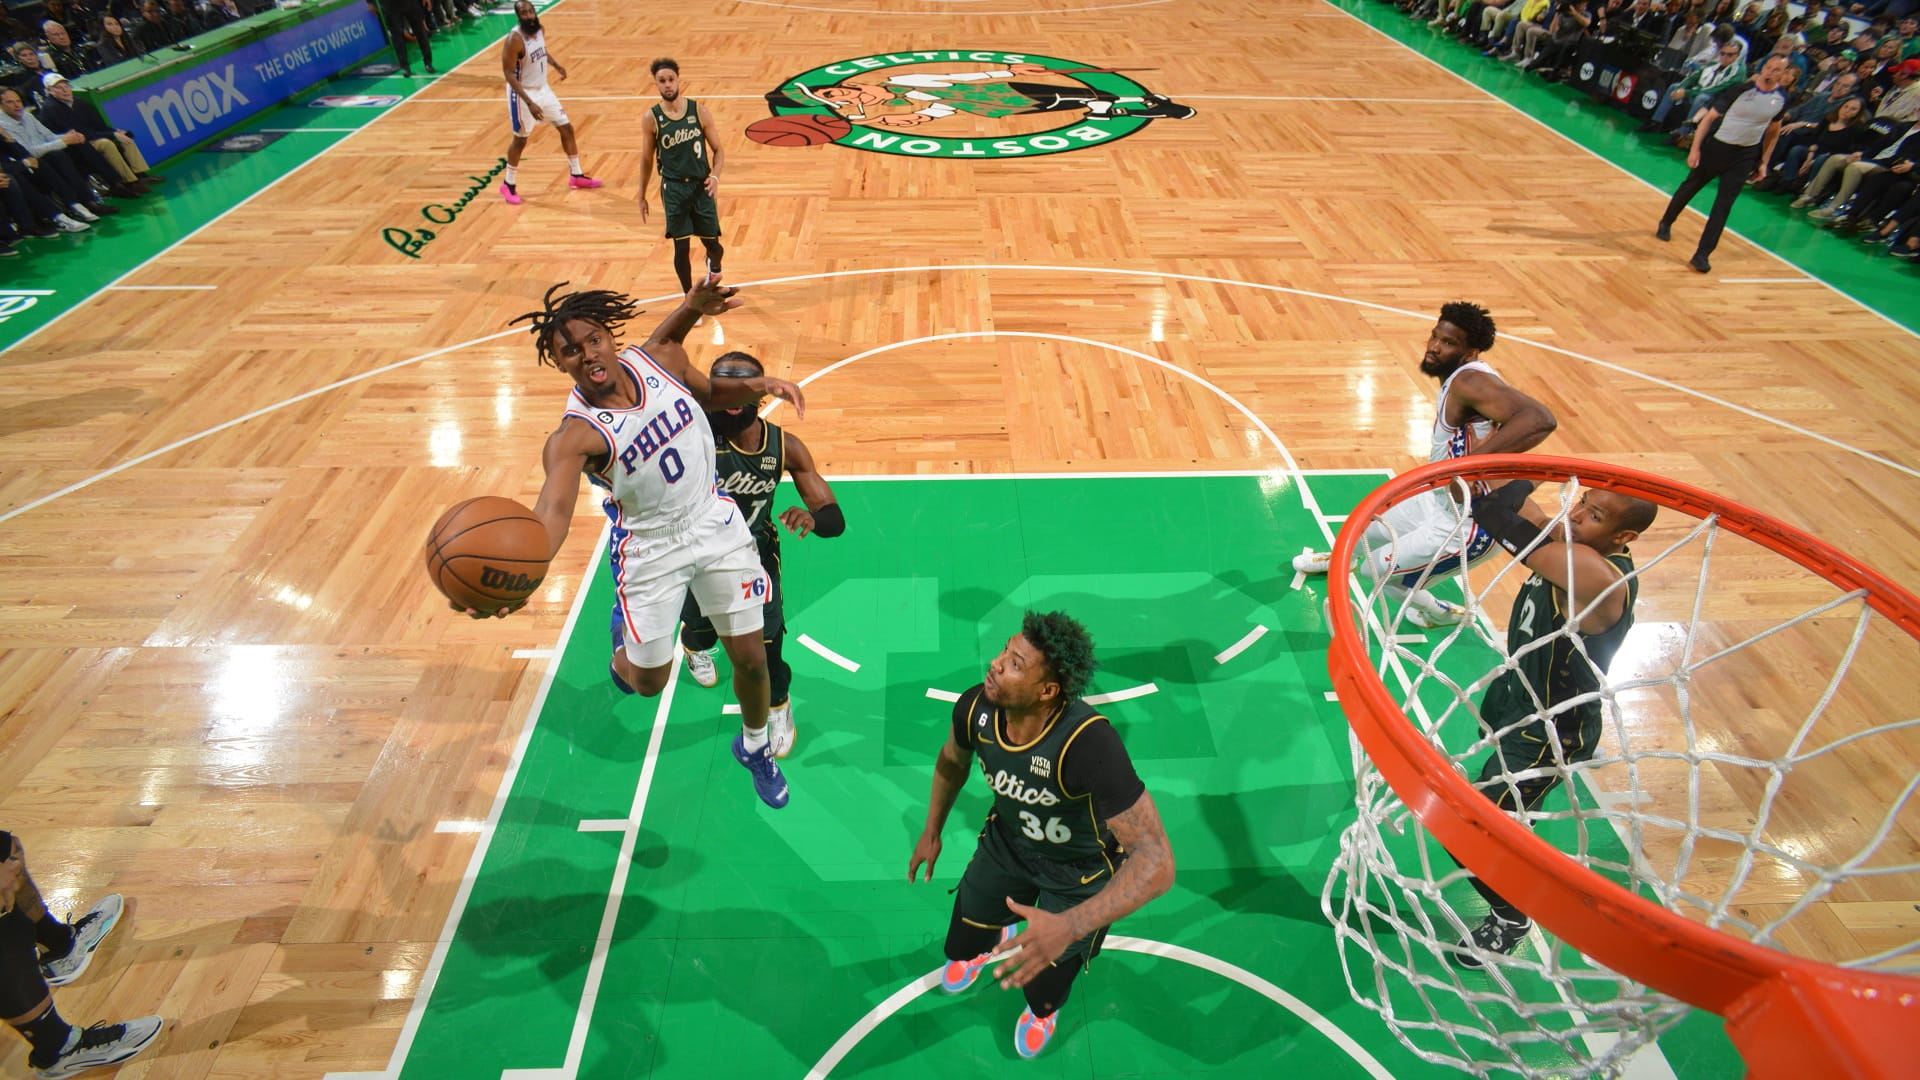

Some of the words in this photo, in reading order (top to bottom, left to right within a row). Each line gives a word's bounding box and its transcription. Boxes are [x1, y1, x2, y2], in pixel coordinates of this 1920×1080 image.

[254, 60, 285, 83] THE
[284, 47, 309, 71] ONE
[309, 39, 328, 58] TO
[326, 20, 367, 51] WATCH
[824, 51, 1026, 77] CELTICS
[136, 63, 250, 147] max
[1643, 95, 1657, 106] TNT
[661, 127, 702, 149] Celtics
[693, 140, 702, 159] 9
[852, 125, 1113, 157] BOSTON
[382, 227, 436, 259] Red
[599, 412, 613, 424] 6
[618, 397, 694, 477] PHILA
[658, 447, 685, 484] 0
[762, 456, 777, 465] VISTA
[715, 471, 777, 495] eltics
[741, 577, 765, 600] 76
[978, 712, 988, 727] 6
[1029, 764, 1051, 779] PRINT
[1031, 755, 1051, 770] VISTA
[1018, 810, 1072, 844] 36
